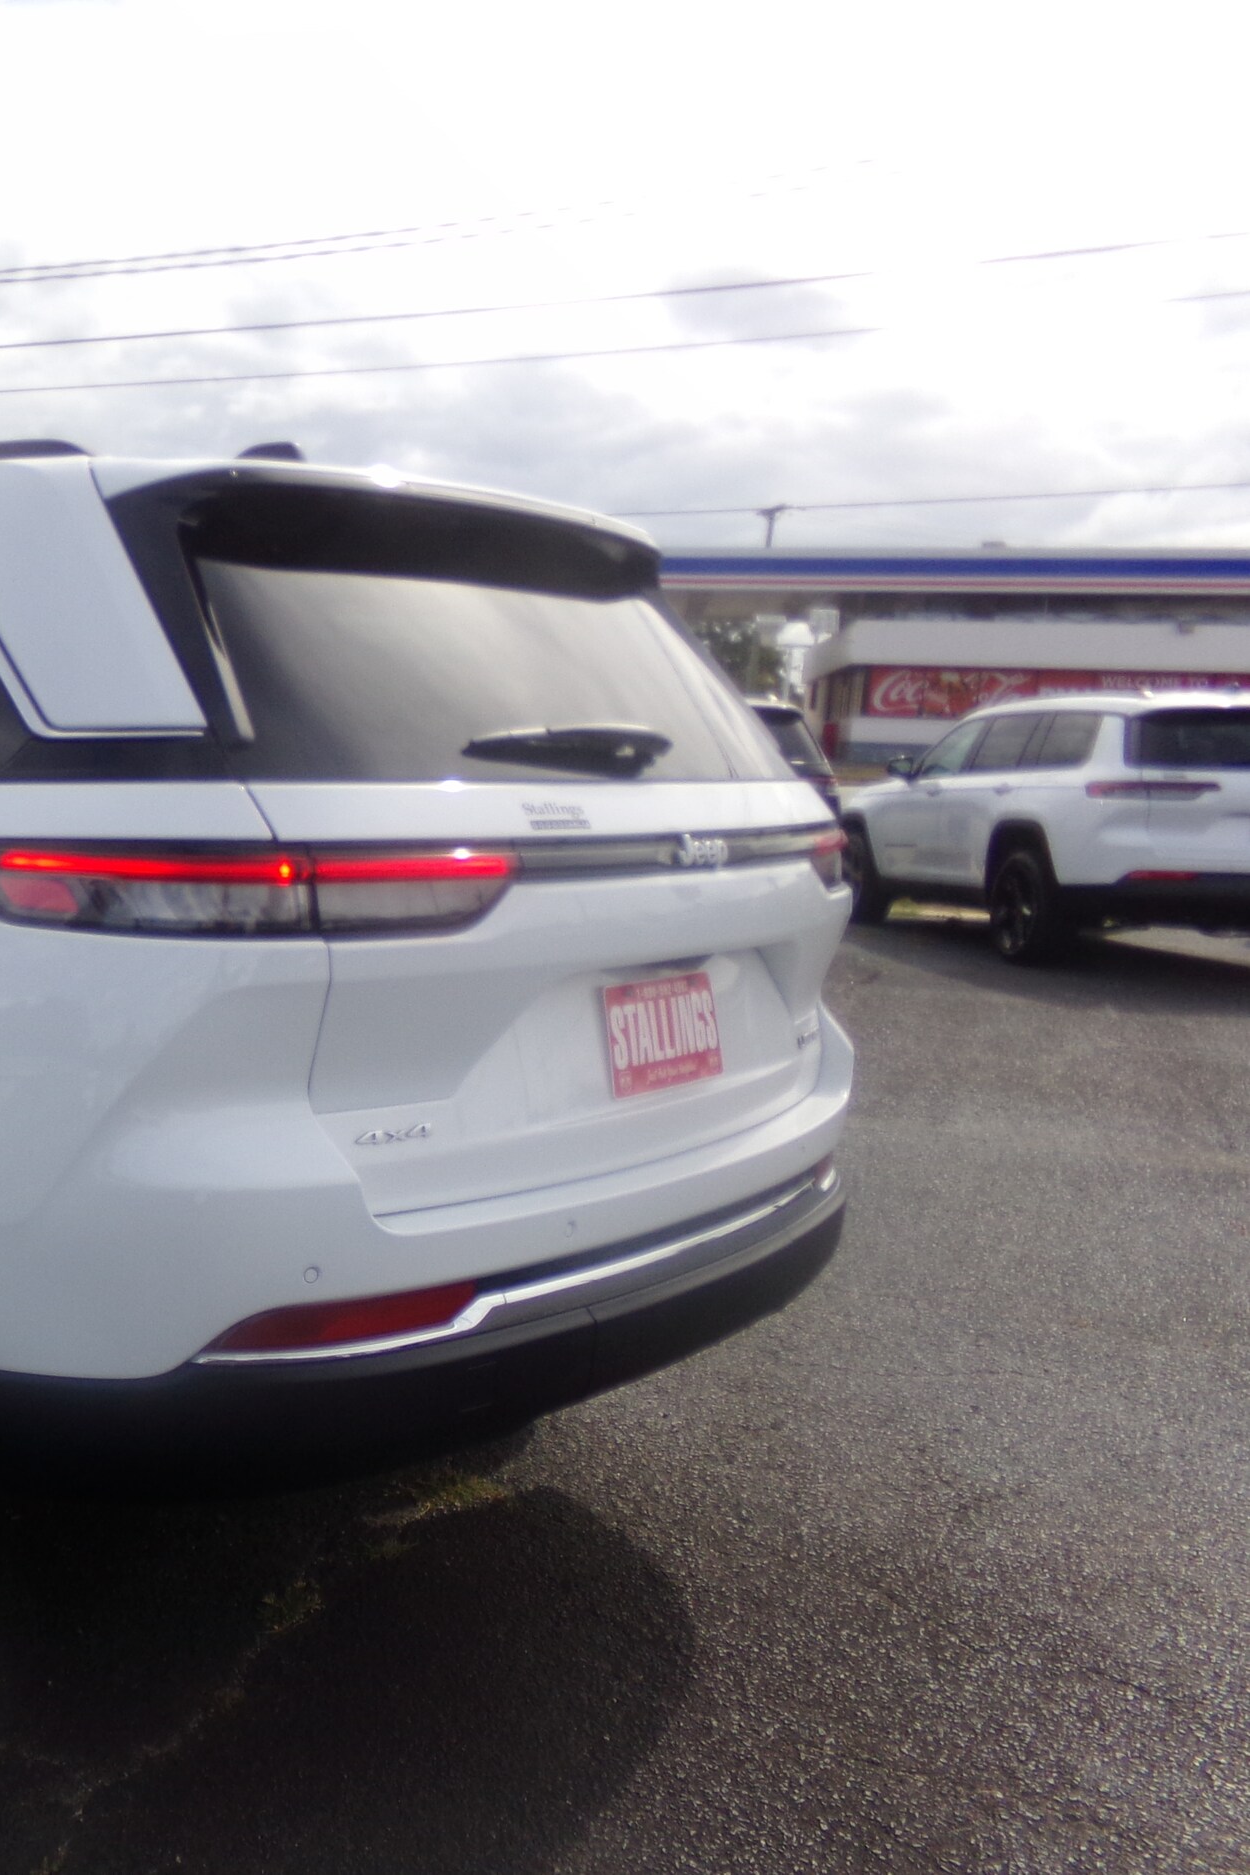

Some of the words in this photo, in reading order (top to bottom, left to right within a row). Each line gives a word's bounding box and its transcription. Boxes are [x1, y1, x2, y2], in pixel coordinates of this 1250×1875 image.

[522, 802, 584, 819] Stallings
[679, 833, 728, 869] Jeep
[610, 990, 718, 1070] STALLINGS
[354, 1123, 431, 1145] 4x4
